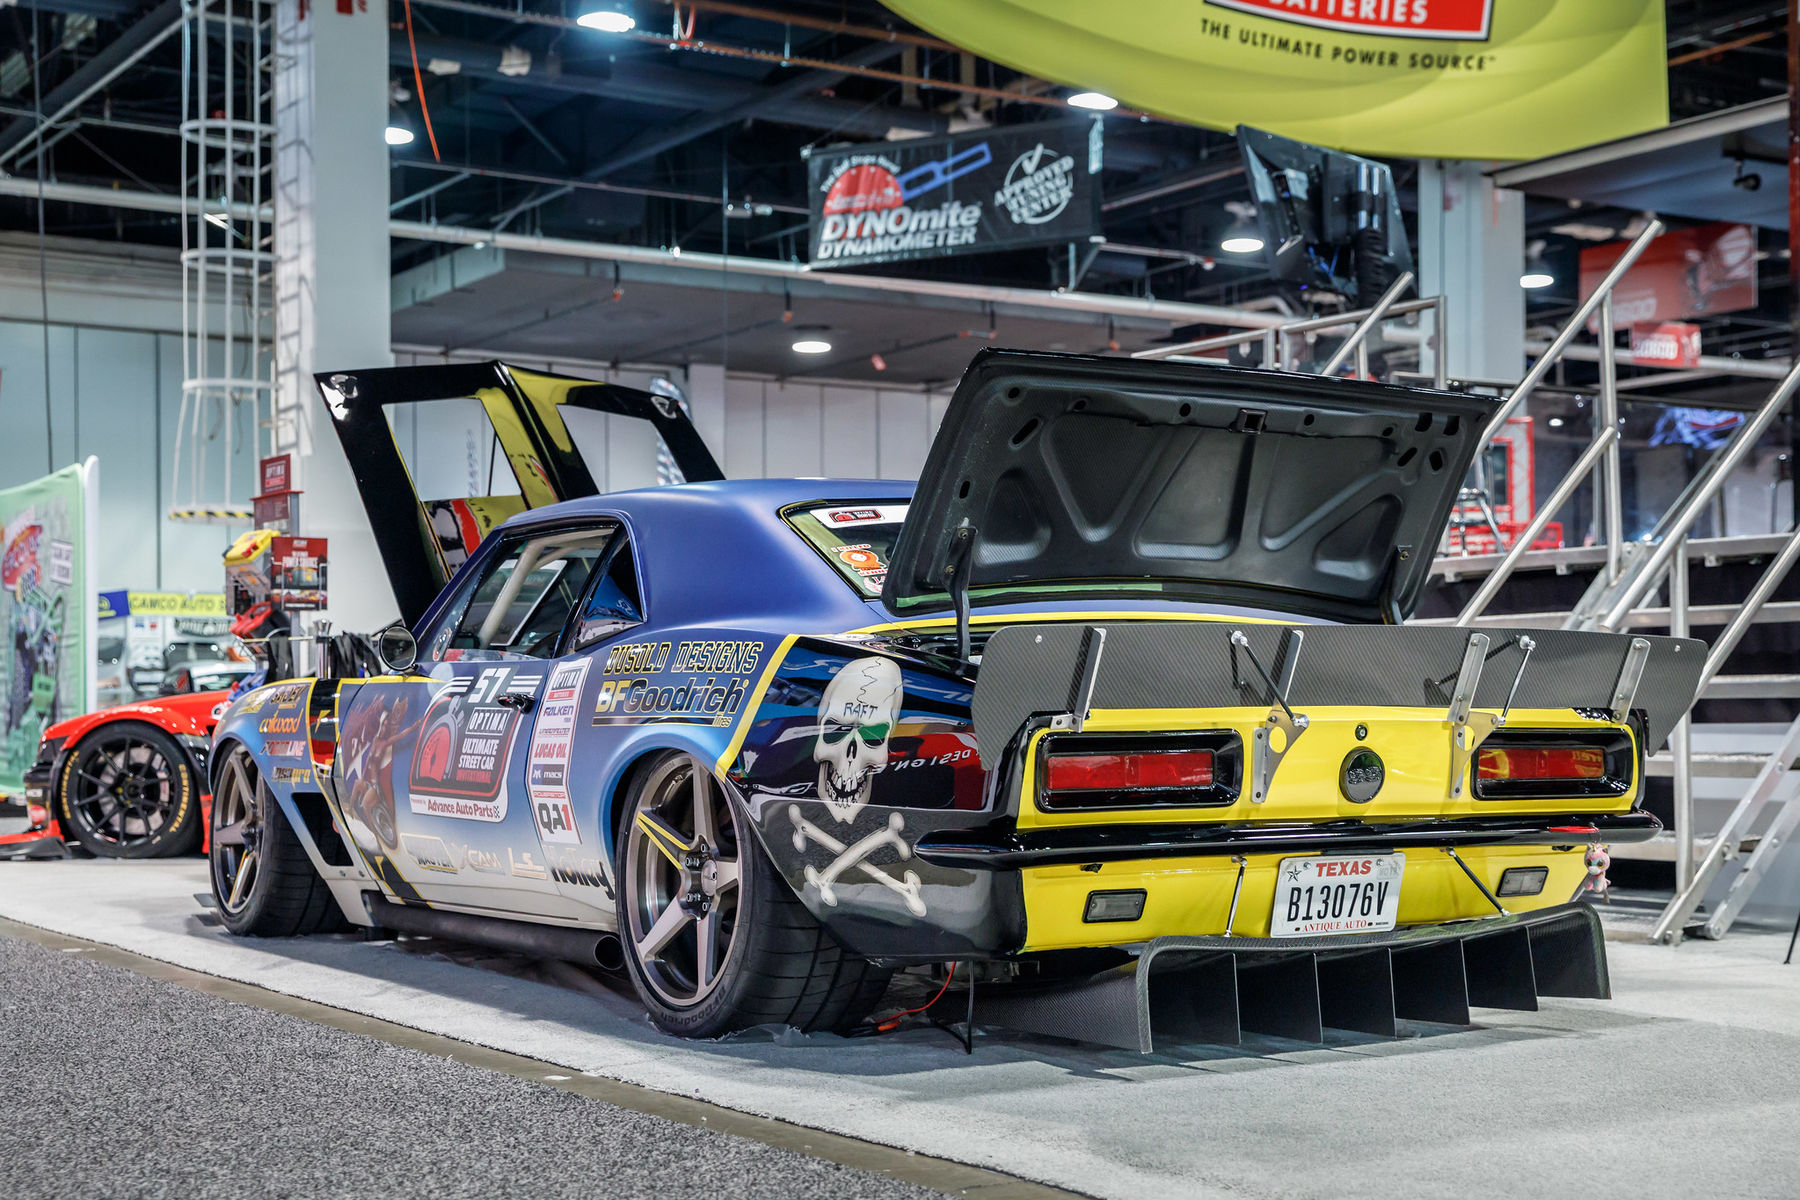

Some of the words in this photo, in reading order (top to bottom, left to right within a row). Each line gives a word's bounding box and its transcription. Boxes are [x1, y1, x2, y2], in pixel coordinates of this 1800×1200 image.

[1201, 18, 1230, 40] THE
[1239, 28, 1322, 59] ULTIMATE
[1331, 46, 1399, 67] POWER
[821, 201, 983, 242] DYNOmite
[816, 226, 978, 260] DYNAMOMETER
[182, 597, 216, 611] AUTO
[603, 642, 671, 675] DUSOLD
[671, 641, 764, 674] DESIGNS
[468, 667, 510, 703] 57
[552, 671, 580, 689] OPTIMA
[543, 706, 574, 716] FALKEN
[843, 702, 878, 718] RAFT
[469, 711, 507, 732] OPTIMA
[462, 738, 499, 756] ULTIMATE
[534, 743, 557, 758] LUCAS
[556, 743, 567, 758] OIL
[458, 755, 482, 769] STREET
[480, 756, 495, 771] CAR
[427, 799, 455, 814] Advance
[455, 802, 473, 816] Auto
[473, 804, 494, 818] Parts
[538, 803, 572, 834] QA1
[1316, 860, 1372, 877] TEXAS
[1286, 881, 1389, 922] B13076V
[1302, 921, 1341, 932] ANTIQUE
[1344, 920, 1367, 930] AUTO
